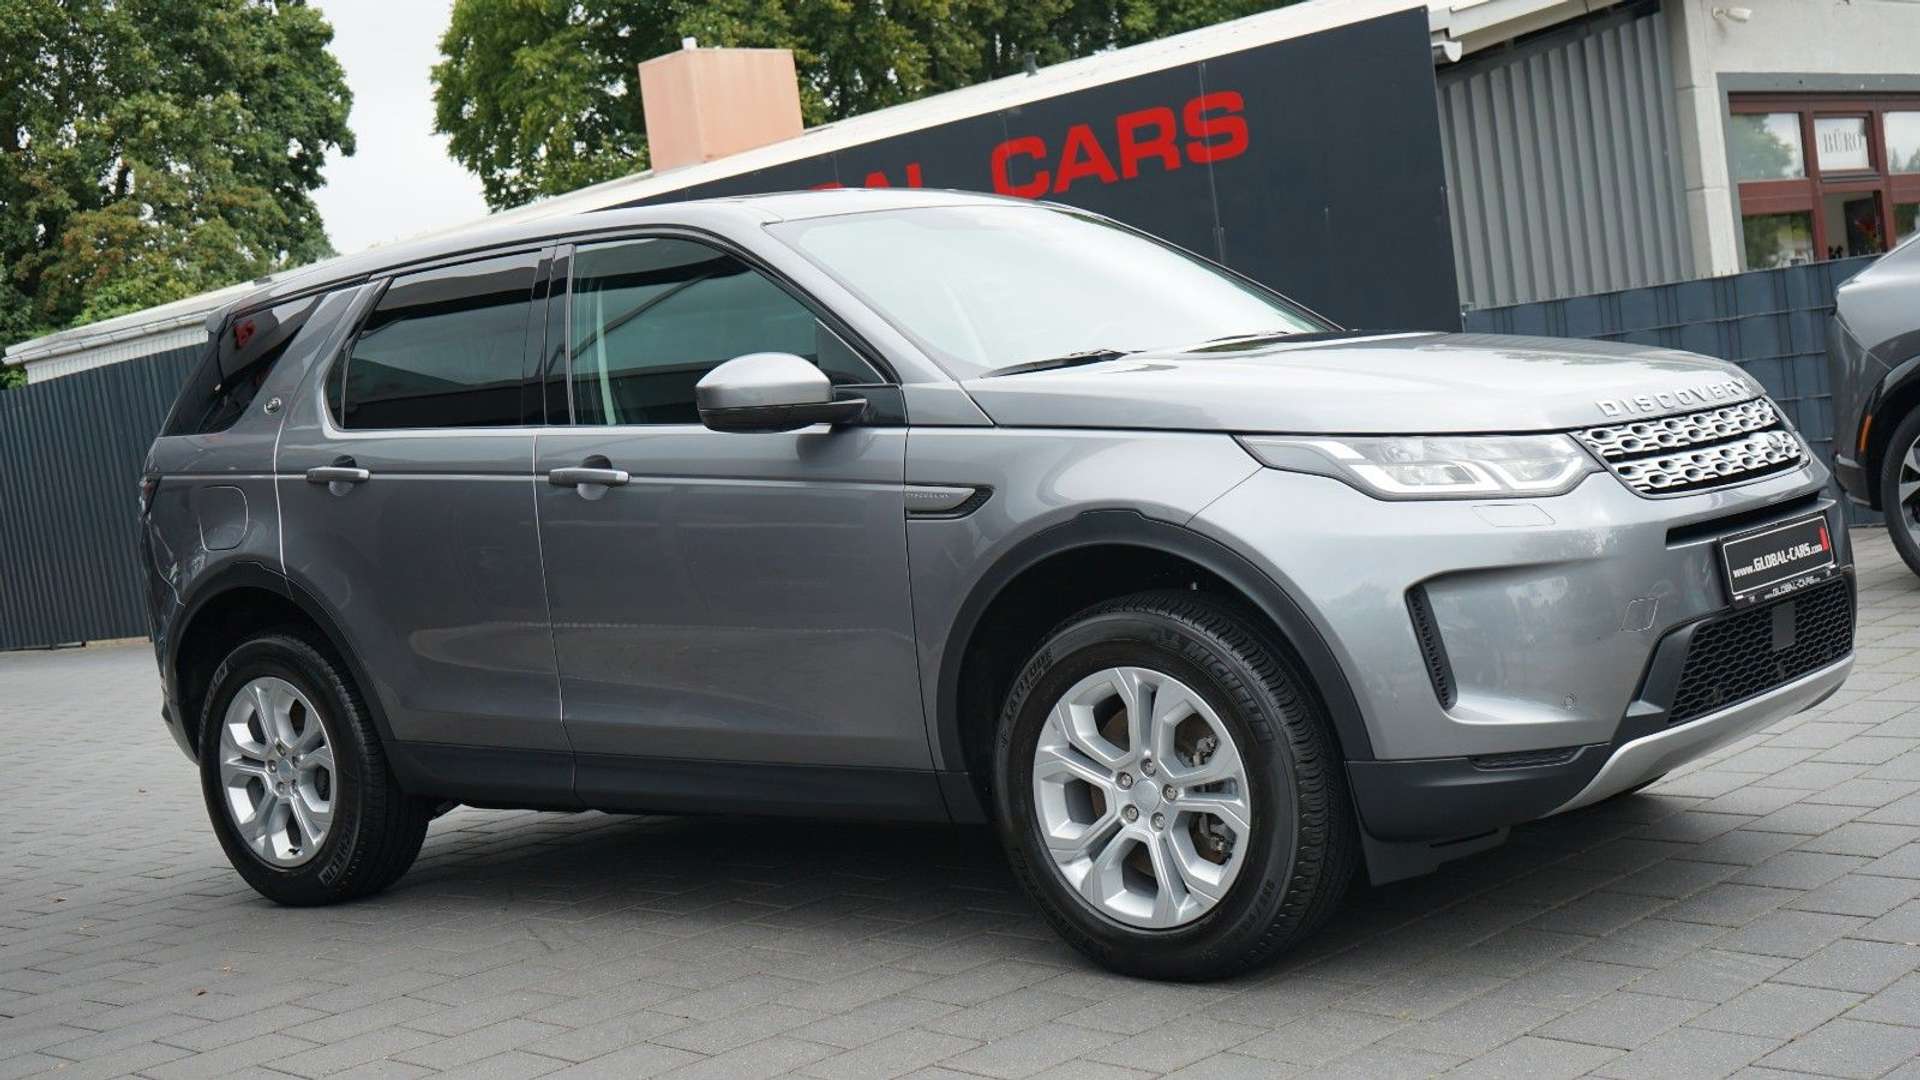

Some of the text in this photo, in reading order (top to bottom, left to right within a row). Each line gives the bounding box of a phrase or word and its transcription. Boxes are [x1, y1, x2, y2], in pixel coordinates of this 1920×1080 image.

[991, 90, 1249, 200] CARS
[1823, 128, 1863, 153] BÜRO
[1595, 377, 1751, 417] DISCOVERY
[1732, 542, 1822, 578] www.GLOBAL-CARS.com
